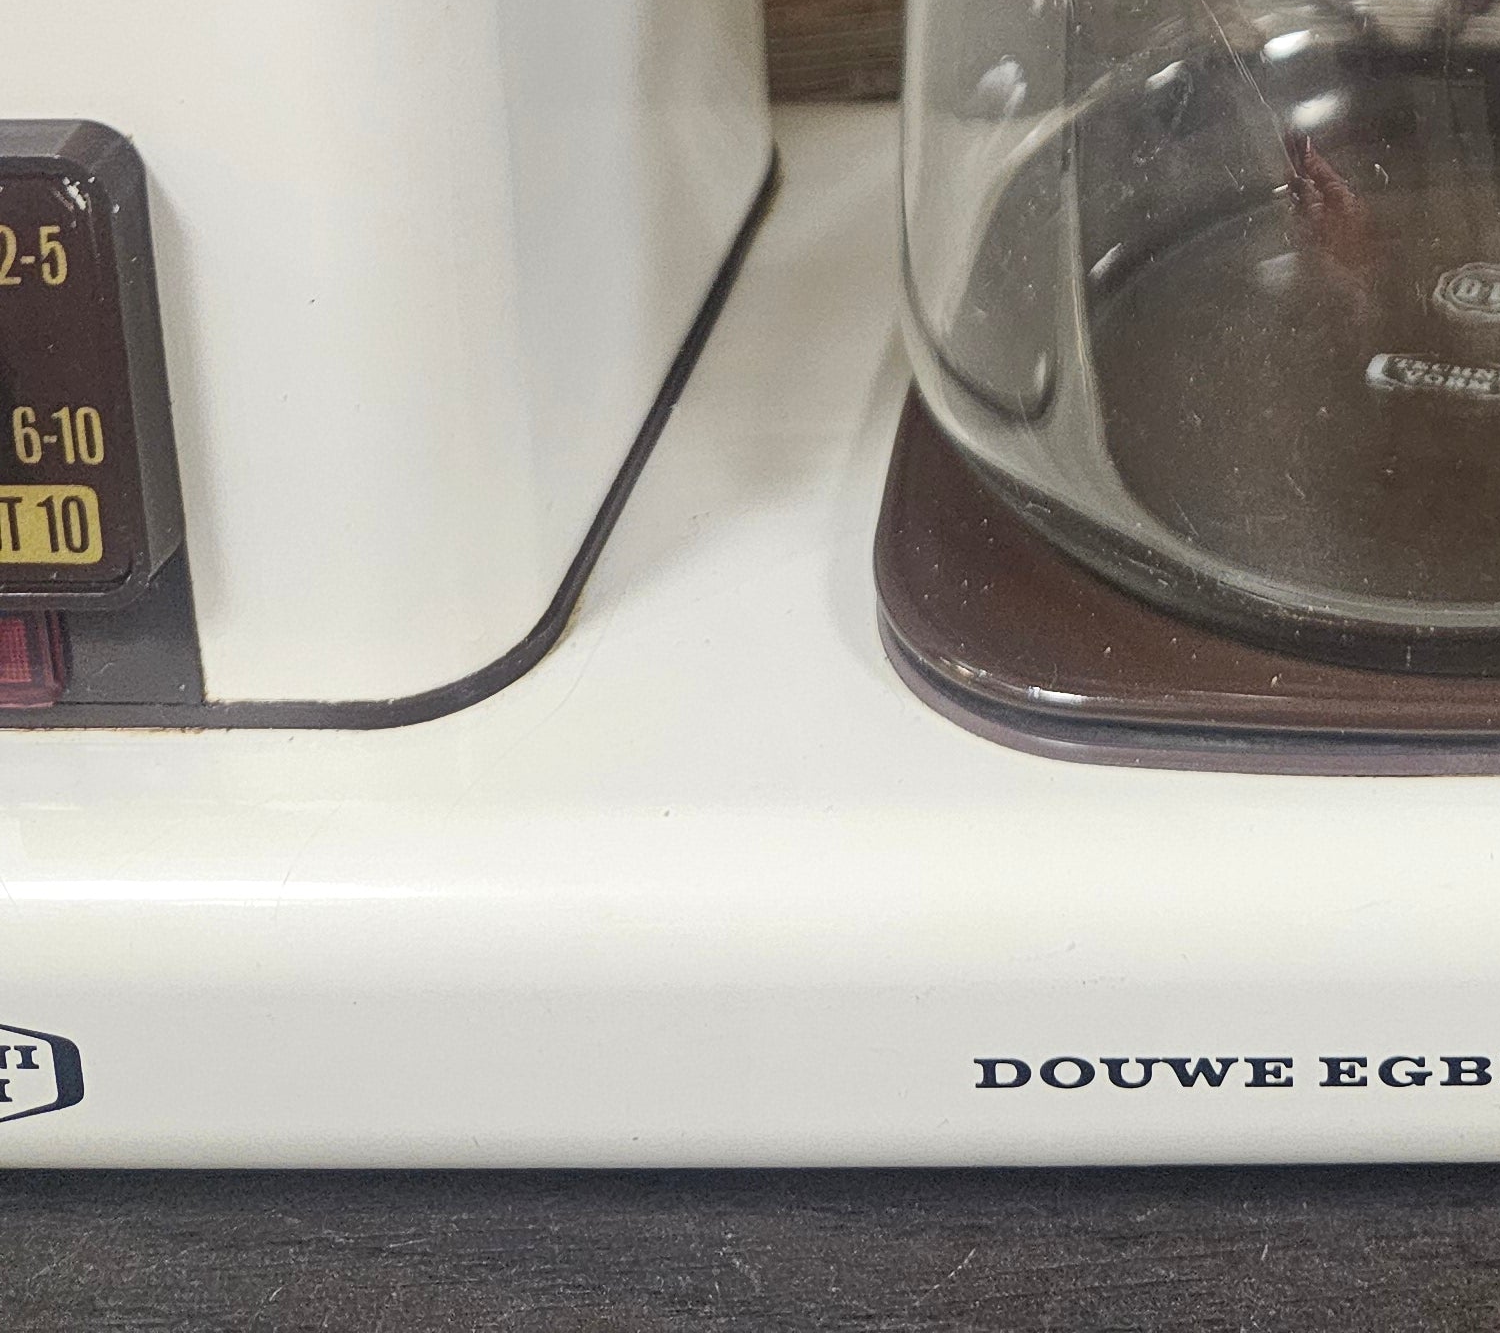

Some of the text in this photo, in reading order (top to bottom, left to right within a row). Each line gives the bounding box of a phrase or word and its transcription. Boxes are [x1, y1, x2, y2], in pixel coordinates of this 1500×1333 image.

[0, 224, 68, 286] 2-5
[12, 406, 105, 465] 6-10
[36, 495, 90, 553] 10
[973, 1057, 1294, 1090] DOUWE
